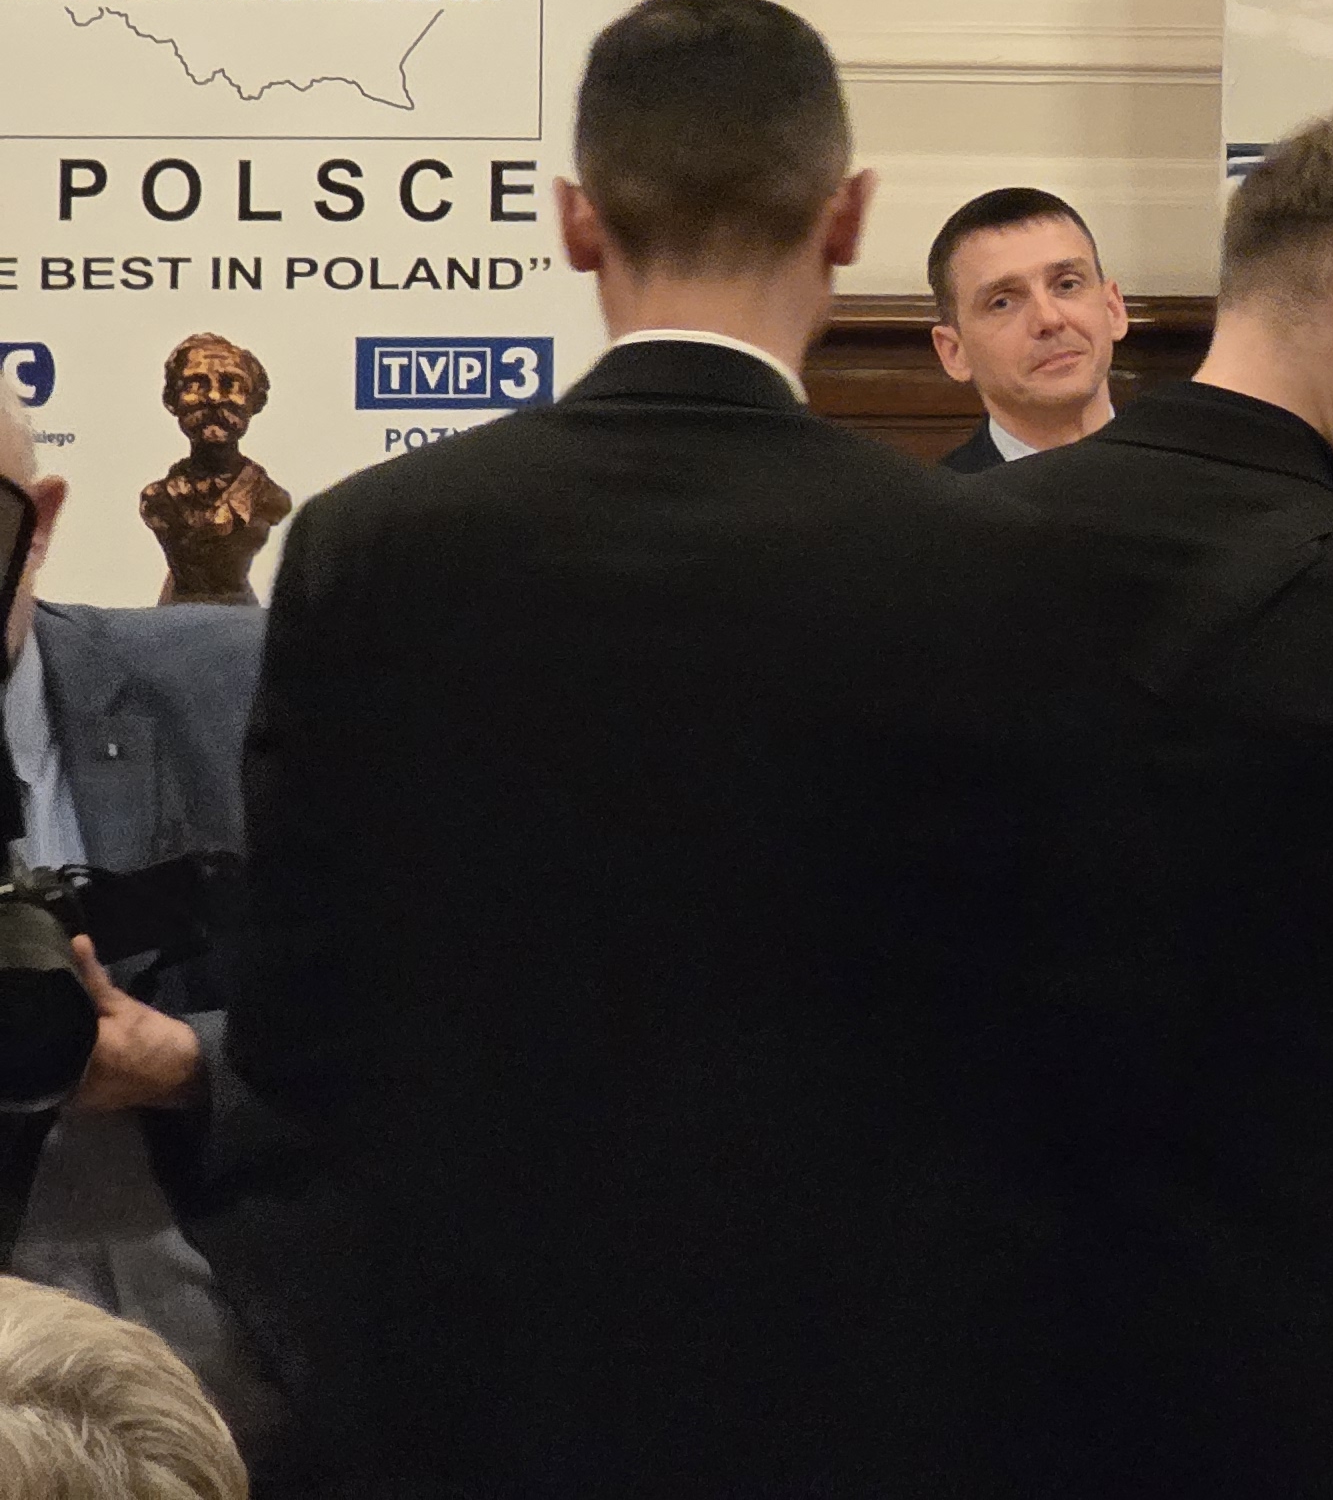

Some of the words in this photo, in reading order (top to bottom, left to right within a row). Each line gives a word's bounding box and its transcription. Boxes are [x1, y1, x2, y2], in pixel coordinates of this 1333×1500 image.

[59, 158, 537, 223] POLSCE
[40, 256, 192, 291] BEST
[211, 256, 262, 290] IN
